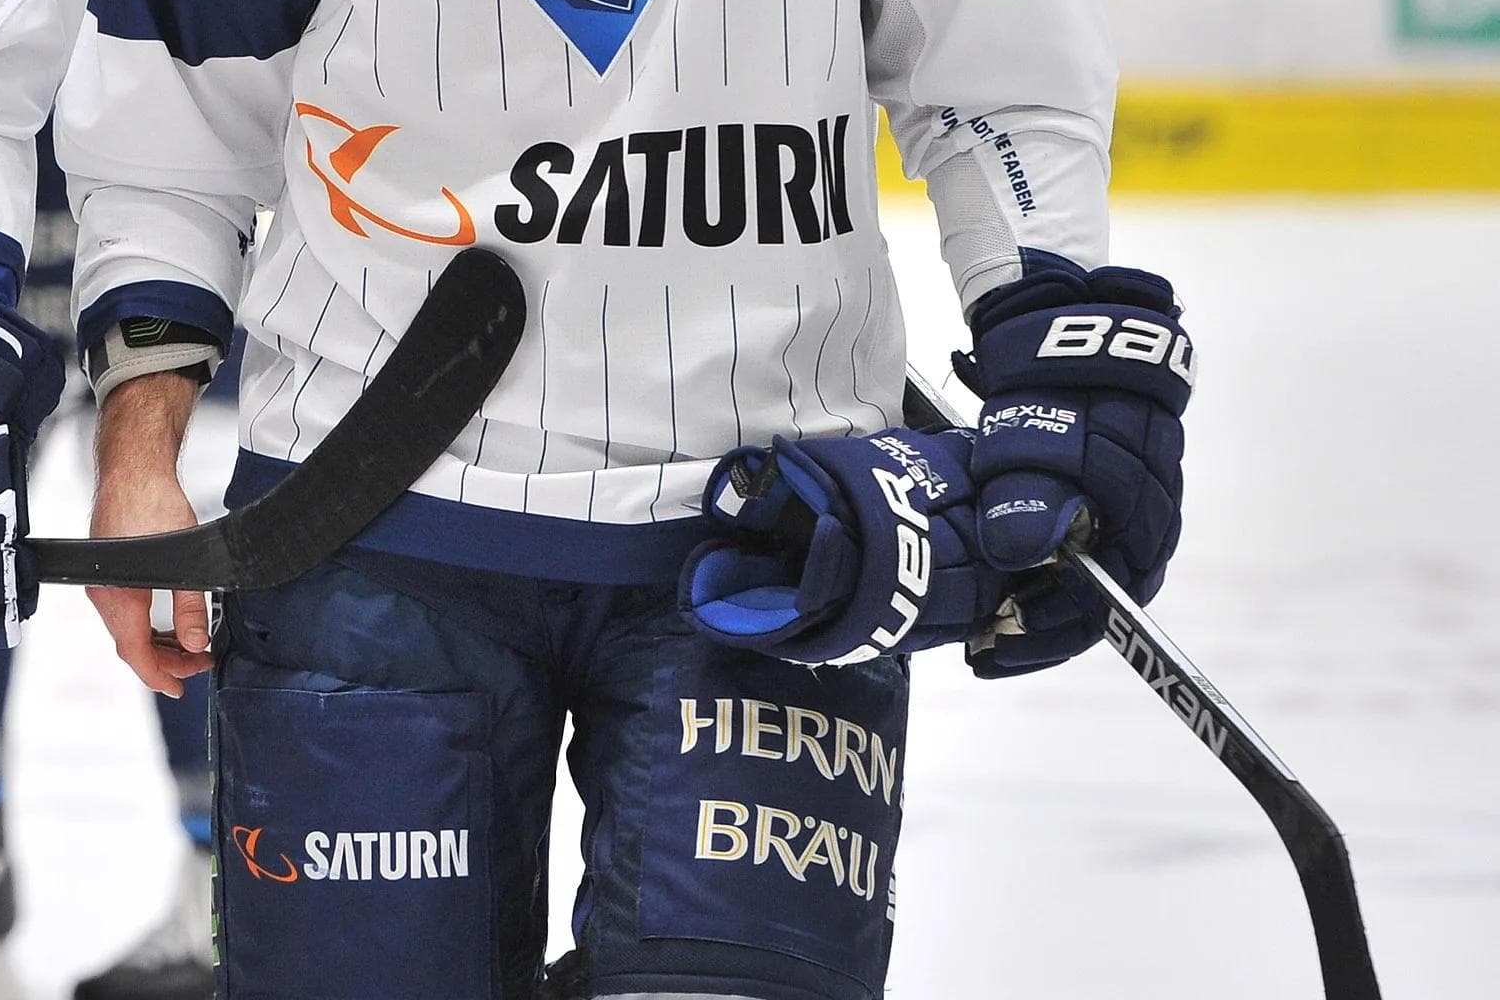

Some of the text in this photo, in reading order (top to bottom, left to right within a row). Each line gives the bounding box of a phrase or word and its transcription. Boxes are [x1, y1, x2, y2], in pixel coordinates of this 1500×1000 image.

[494, 114, 854, 248] SATURN
[983, 404, 1077, 425] NEXUS
[1022, 418, 1069, 434] PRO
[1103, 606, 1229, 758] NEXUS
[679, 697, 897, 806] HERRN
[303, 828, 470, 882] SATURN
[693, 799, 879, 901] BRÄU
